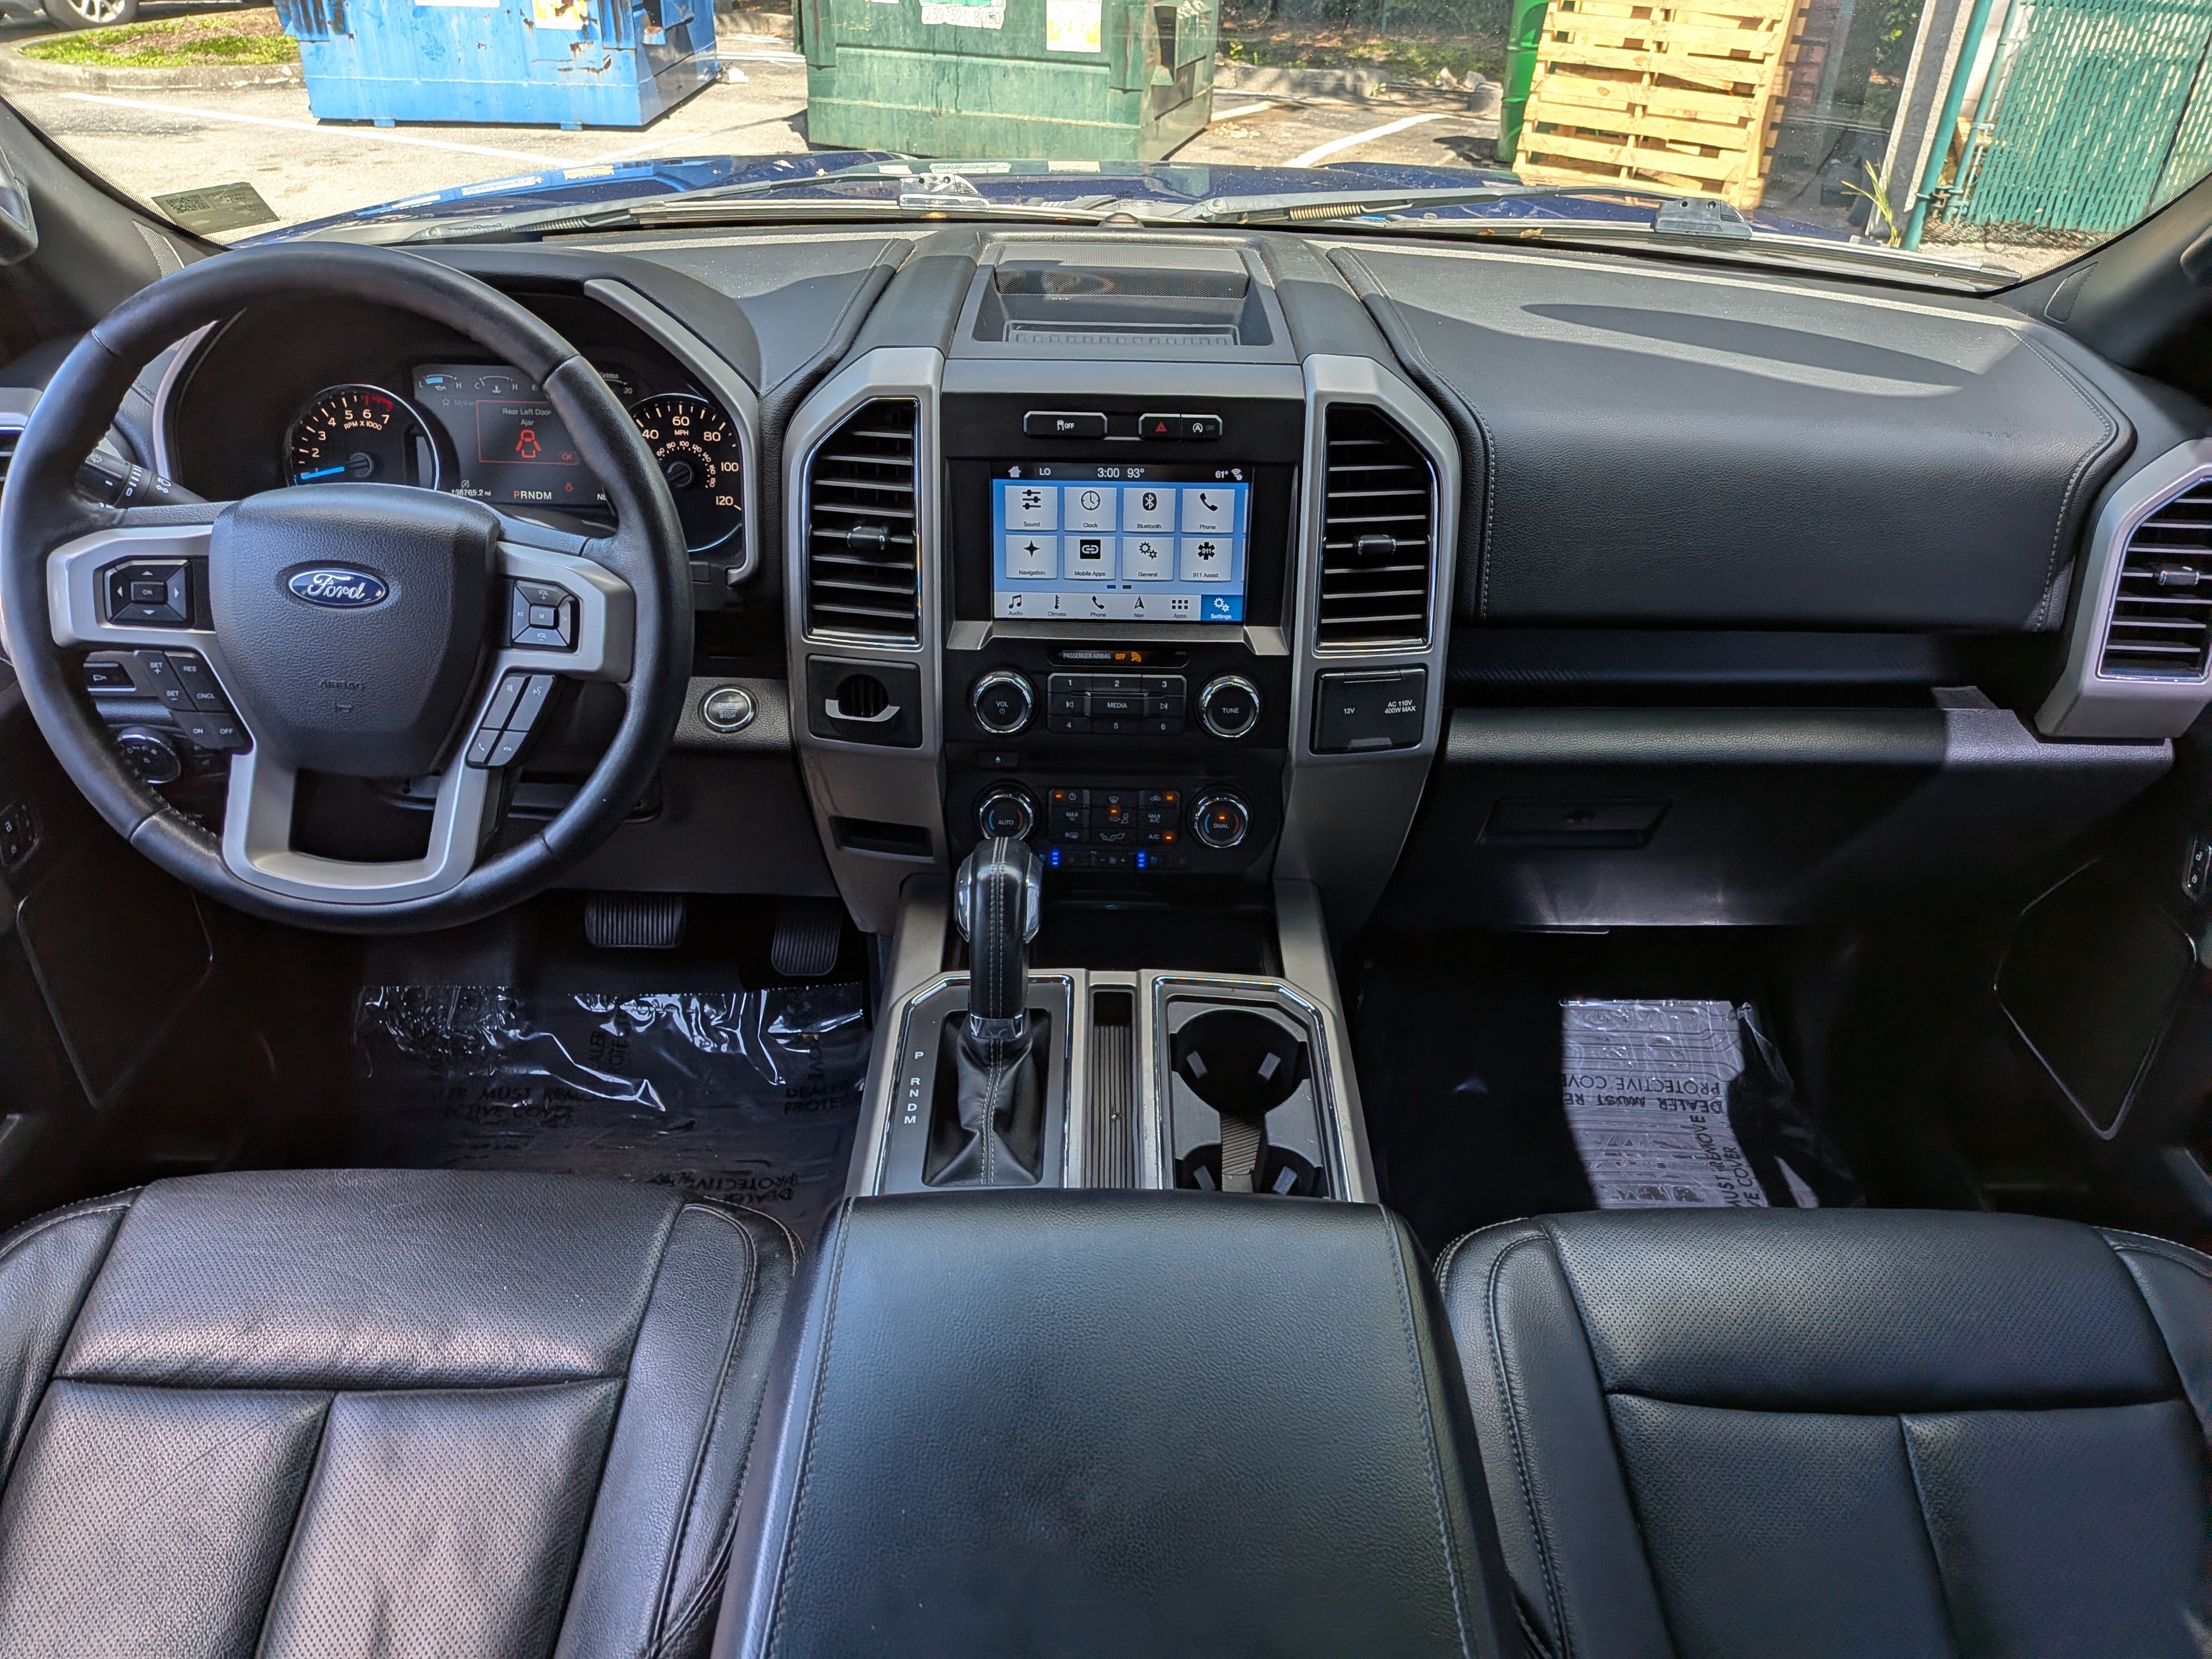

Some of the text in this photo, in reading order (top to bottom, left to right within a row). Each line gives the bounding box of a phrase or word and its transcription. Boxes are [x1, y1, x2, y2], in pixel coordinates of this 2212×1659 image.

[345, 410, 353, 419] 5
[362, 409, 372, 419] 6
[520, 408, 534, 416] Left
[328, 417, 337, 427] 4
[381, 414, 390, 424] 7
[520, 419, 534, 427] Ajar
[672, 416, 690, 426] 60
[343, 421, 358, 431] RPM
[366, 421, 382, 431] 1000
[318, 431, 326, 441] 3
[642, 429, 659, 440] 40
[703, 431, 721, 442] 80
[666, 441, 676, 449] 80
[692, 444, 702, 453] 120
[311, 448, 320, 458] 2
[656, 447, 665, 457] 60
[702, 451, 712, 463] 140
[721, 461, 739, 472] 100
[1039, 467, 1051, 476] LO
[1097, 467, 1145, 478] 3:00 93°
[1214, 470, 1229, 479] 61°
[716, 495, 734, 506] 120
[307, 573, 366, 599] Ford
[1398, 699, 1413, 707] 110V
[914, 1051, 924, 1060] P
[910, 1077, 920, 1086] R
[1616, 1077, 1720, 1095] PROTECTIVE
[909, 1089, 919, 1098] N
[907, 1103, 917, 1112] D
[1657, 1097, 1723, 1114] DEALER
[904, 1115, 916, 1124] M
[1690, 1114, 1726, 1172] REMOVE
[1724, 1146, 1753, 1187] COVER
